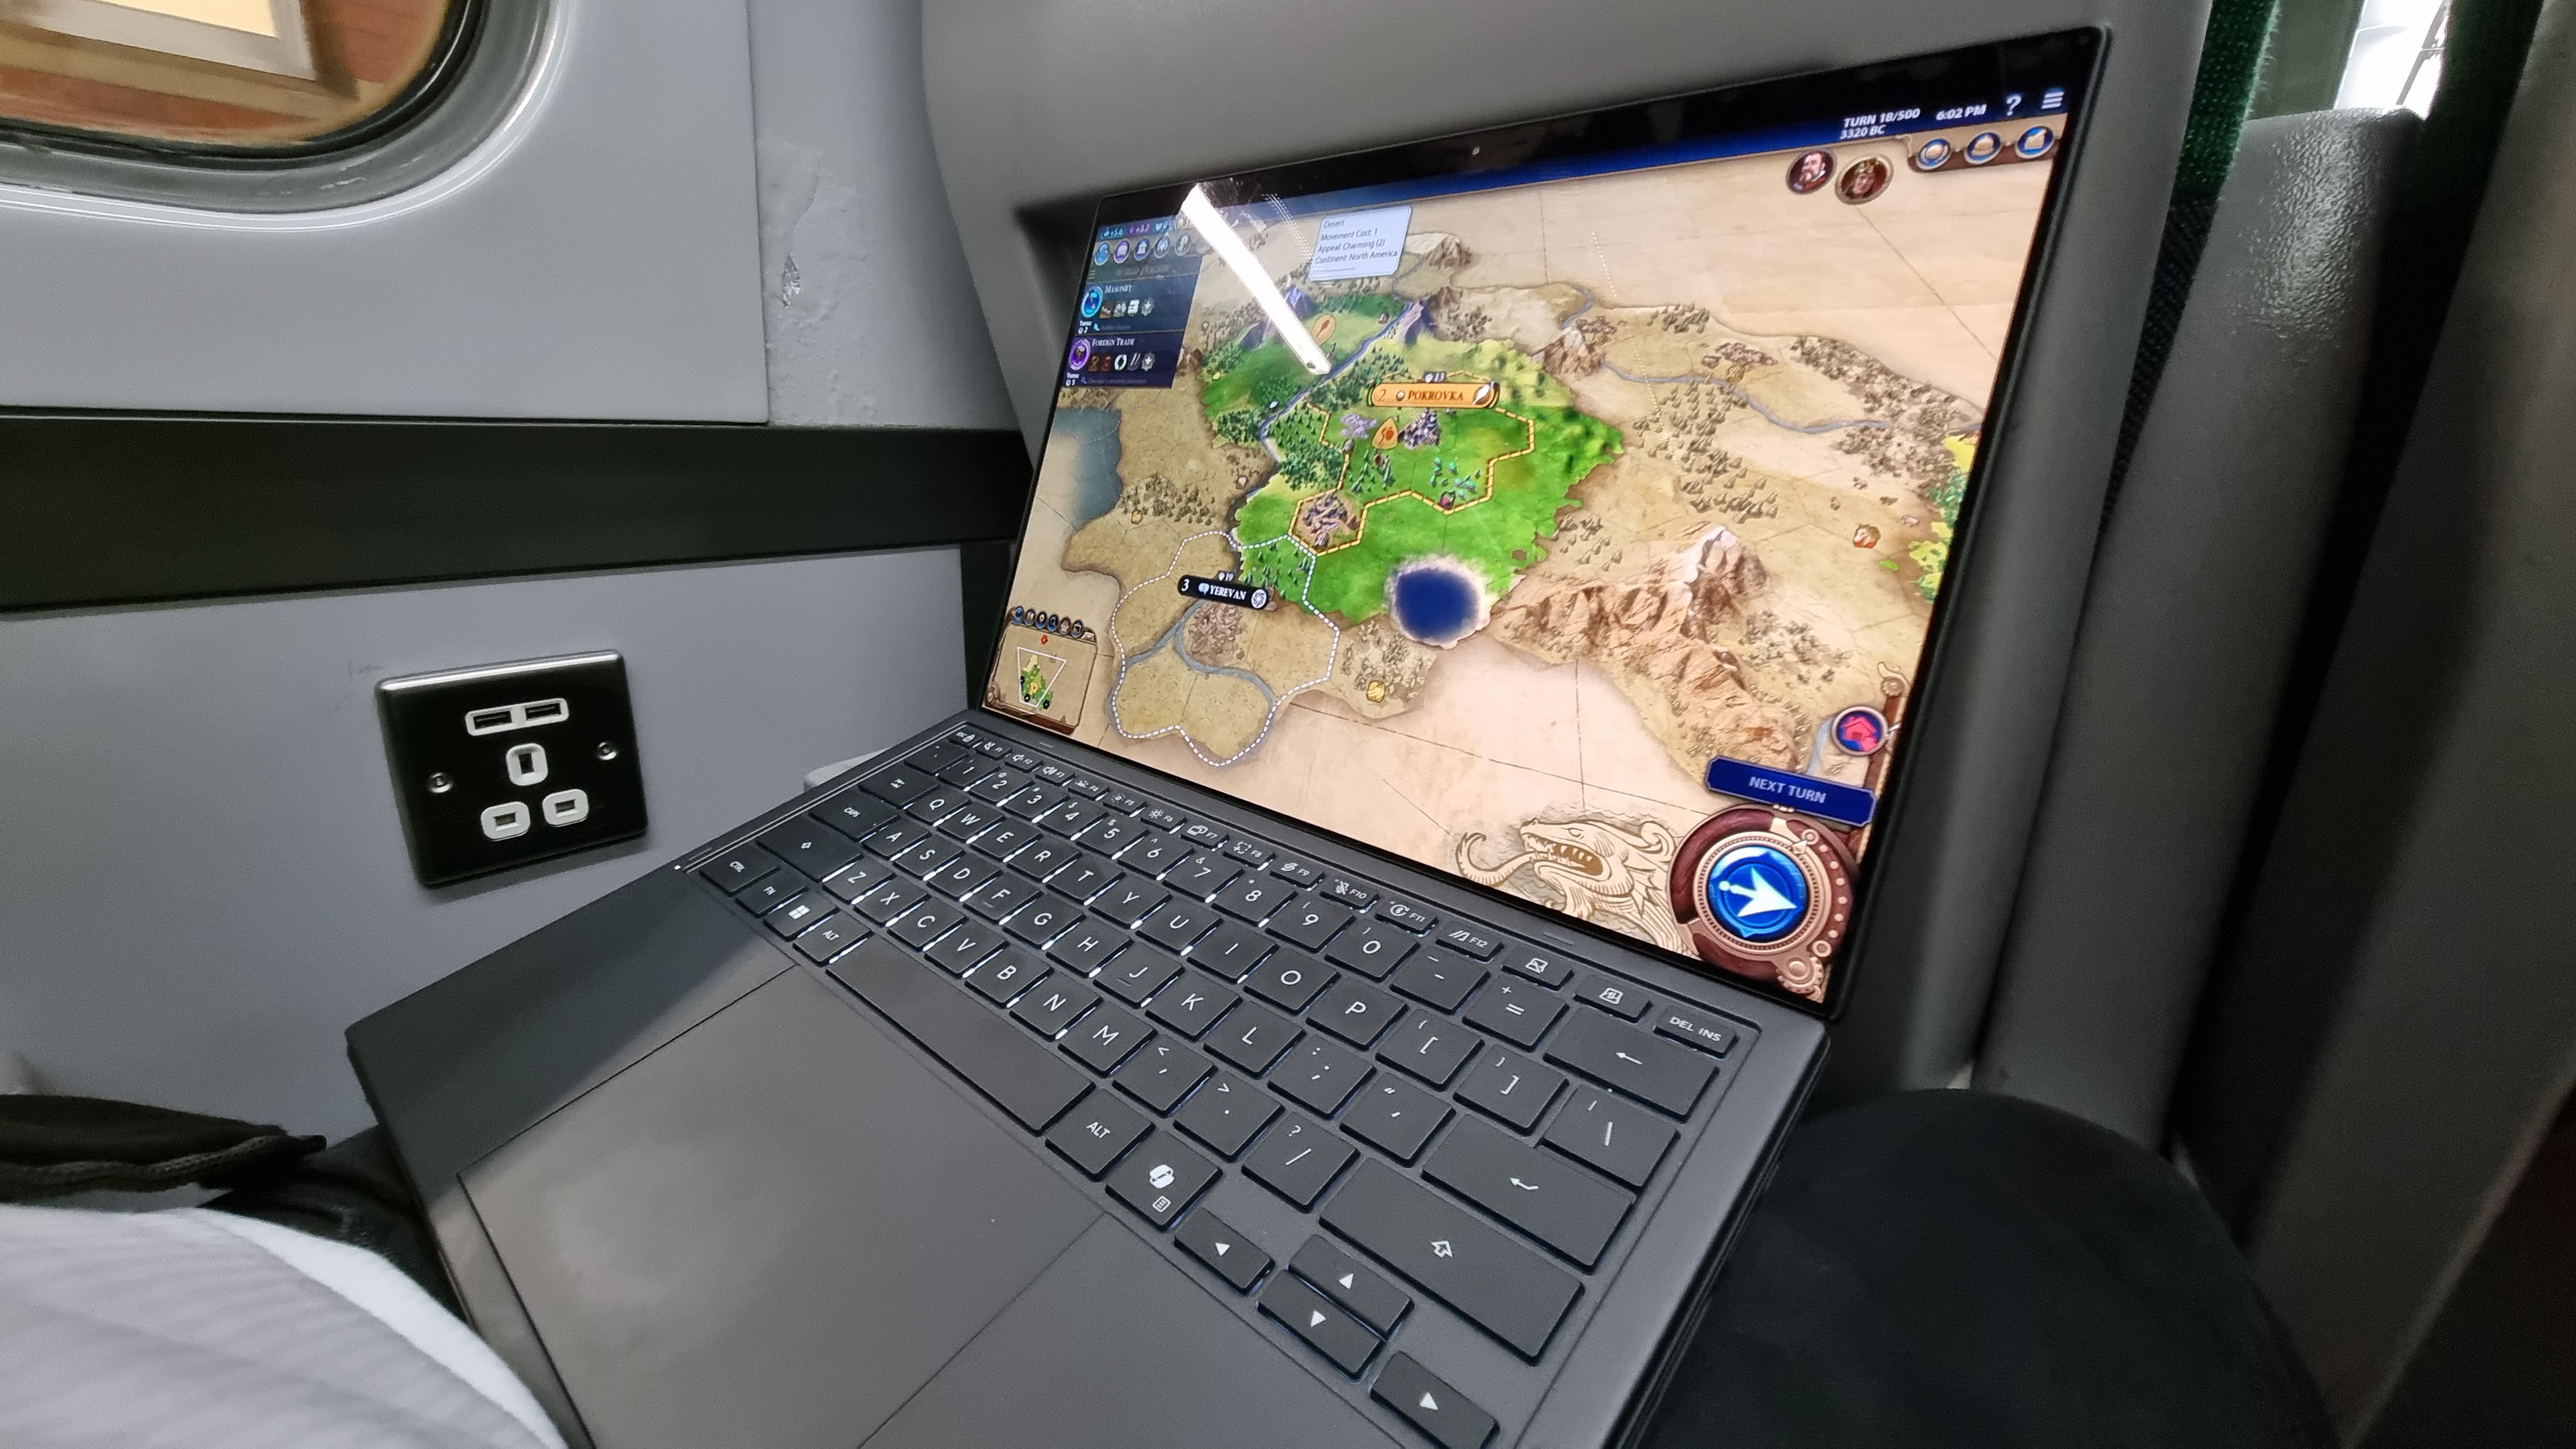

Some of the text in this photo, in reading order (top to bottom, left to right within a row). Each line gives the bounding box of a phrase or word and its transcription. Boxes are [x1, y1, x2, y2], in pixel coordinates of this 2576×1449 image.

[1844, 108, 1920, 128] TURN 18/500
[1935, 103, 1987, 121] 6:02 PM
[1839, 125, 1886, 140] 3320 BC
[1324, 220, 1345, 229] Desert
[1321, 231, 1354, 241] Movement
[1343, 241, 1374, 250] Charming
[1376, 238, 1386, 247] (2)
[1370, 250, 1398, 259] America
[1116, 337, 1135, 346] TRADE
[1377, 388, 1464, 402] 2 POKROVKA
[1225, 572, 1234, 581] 19
[1181, 579, 1246, 600] 3 YEREVAN
[963, 766, 975, 774] 1
[992, 779, 1008, 789] 2
[1749, 776, 1827, 804] NEXT TURN
[929, 799, 945, 811] Q
[1027, 795, 1042, 804] 3
[843, 807, 861, 818] CAPS
[1064, 811, 1080, 821] 4
[960, 813, 981, 825] W
[886, 832, 902, 842] A
[996, 831, 1015, 843] E
[1103, 827, 1121, 839] 5
[919, 849, 936, 860] S
[1034, 850, 1052, 862] R
[1147, 848, 1163, 858] 6
[1250, 850, 1262, 858] F8
[847, 871, 867, 884] Z
[953, 868, 971, 880] D
[1078, 870, 1094, 882] T
[1193, 867, 1211, 878] 7
[1297, 868, 1310, 877] F9
[763, 885, 776, 896] FN
[991, 889, 1011, 900] F
[1245, 889, 1262, 901] 8
[1349, 889, 1367, 899] F10
[880, 891, 900, 905] X
[1122, 891, 1140, 904] Y
[917, 915, 935, 928] C
[1034, 912, 1052, 925] G
[1169, 915, 1190, 929] U
[1302, 914, 1319, 926] 9
[1409, 912, 1426, 923] F11
[822, 930, 839, 941] ALT
[957, 938, 976, 951] V
[1077, 936, 1099, 952] H
[1469, 937, 1488, 948] F12
[997, 965, 1016, 980] B
[1129, 967, 1148, 978] J
[1043, 993, 1066, 1011] N
[1181, 993, 1204, 1011] K
[1344, 1001, 1367, 1015] P
[1505, 1003, 1525, 1015] =
[1669, 1016, 1722, 1041] DEL INS
[1092, 1025, 1119, 1046] M
[1241, 1027, 1257, 1045] L
[1086, 1121, 1111, 1138] ALT
[1288, 1124, 1301, 1137] ?
